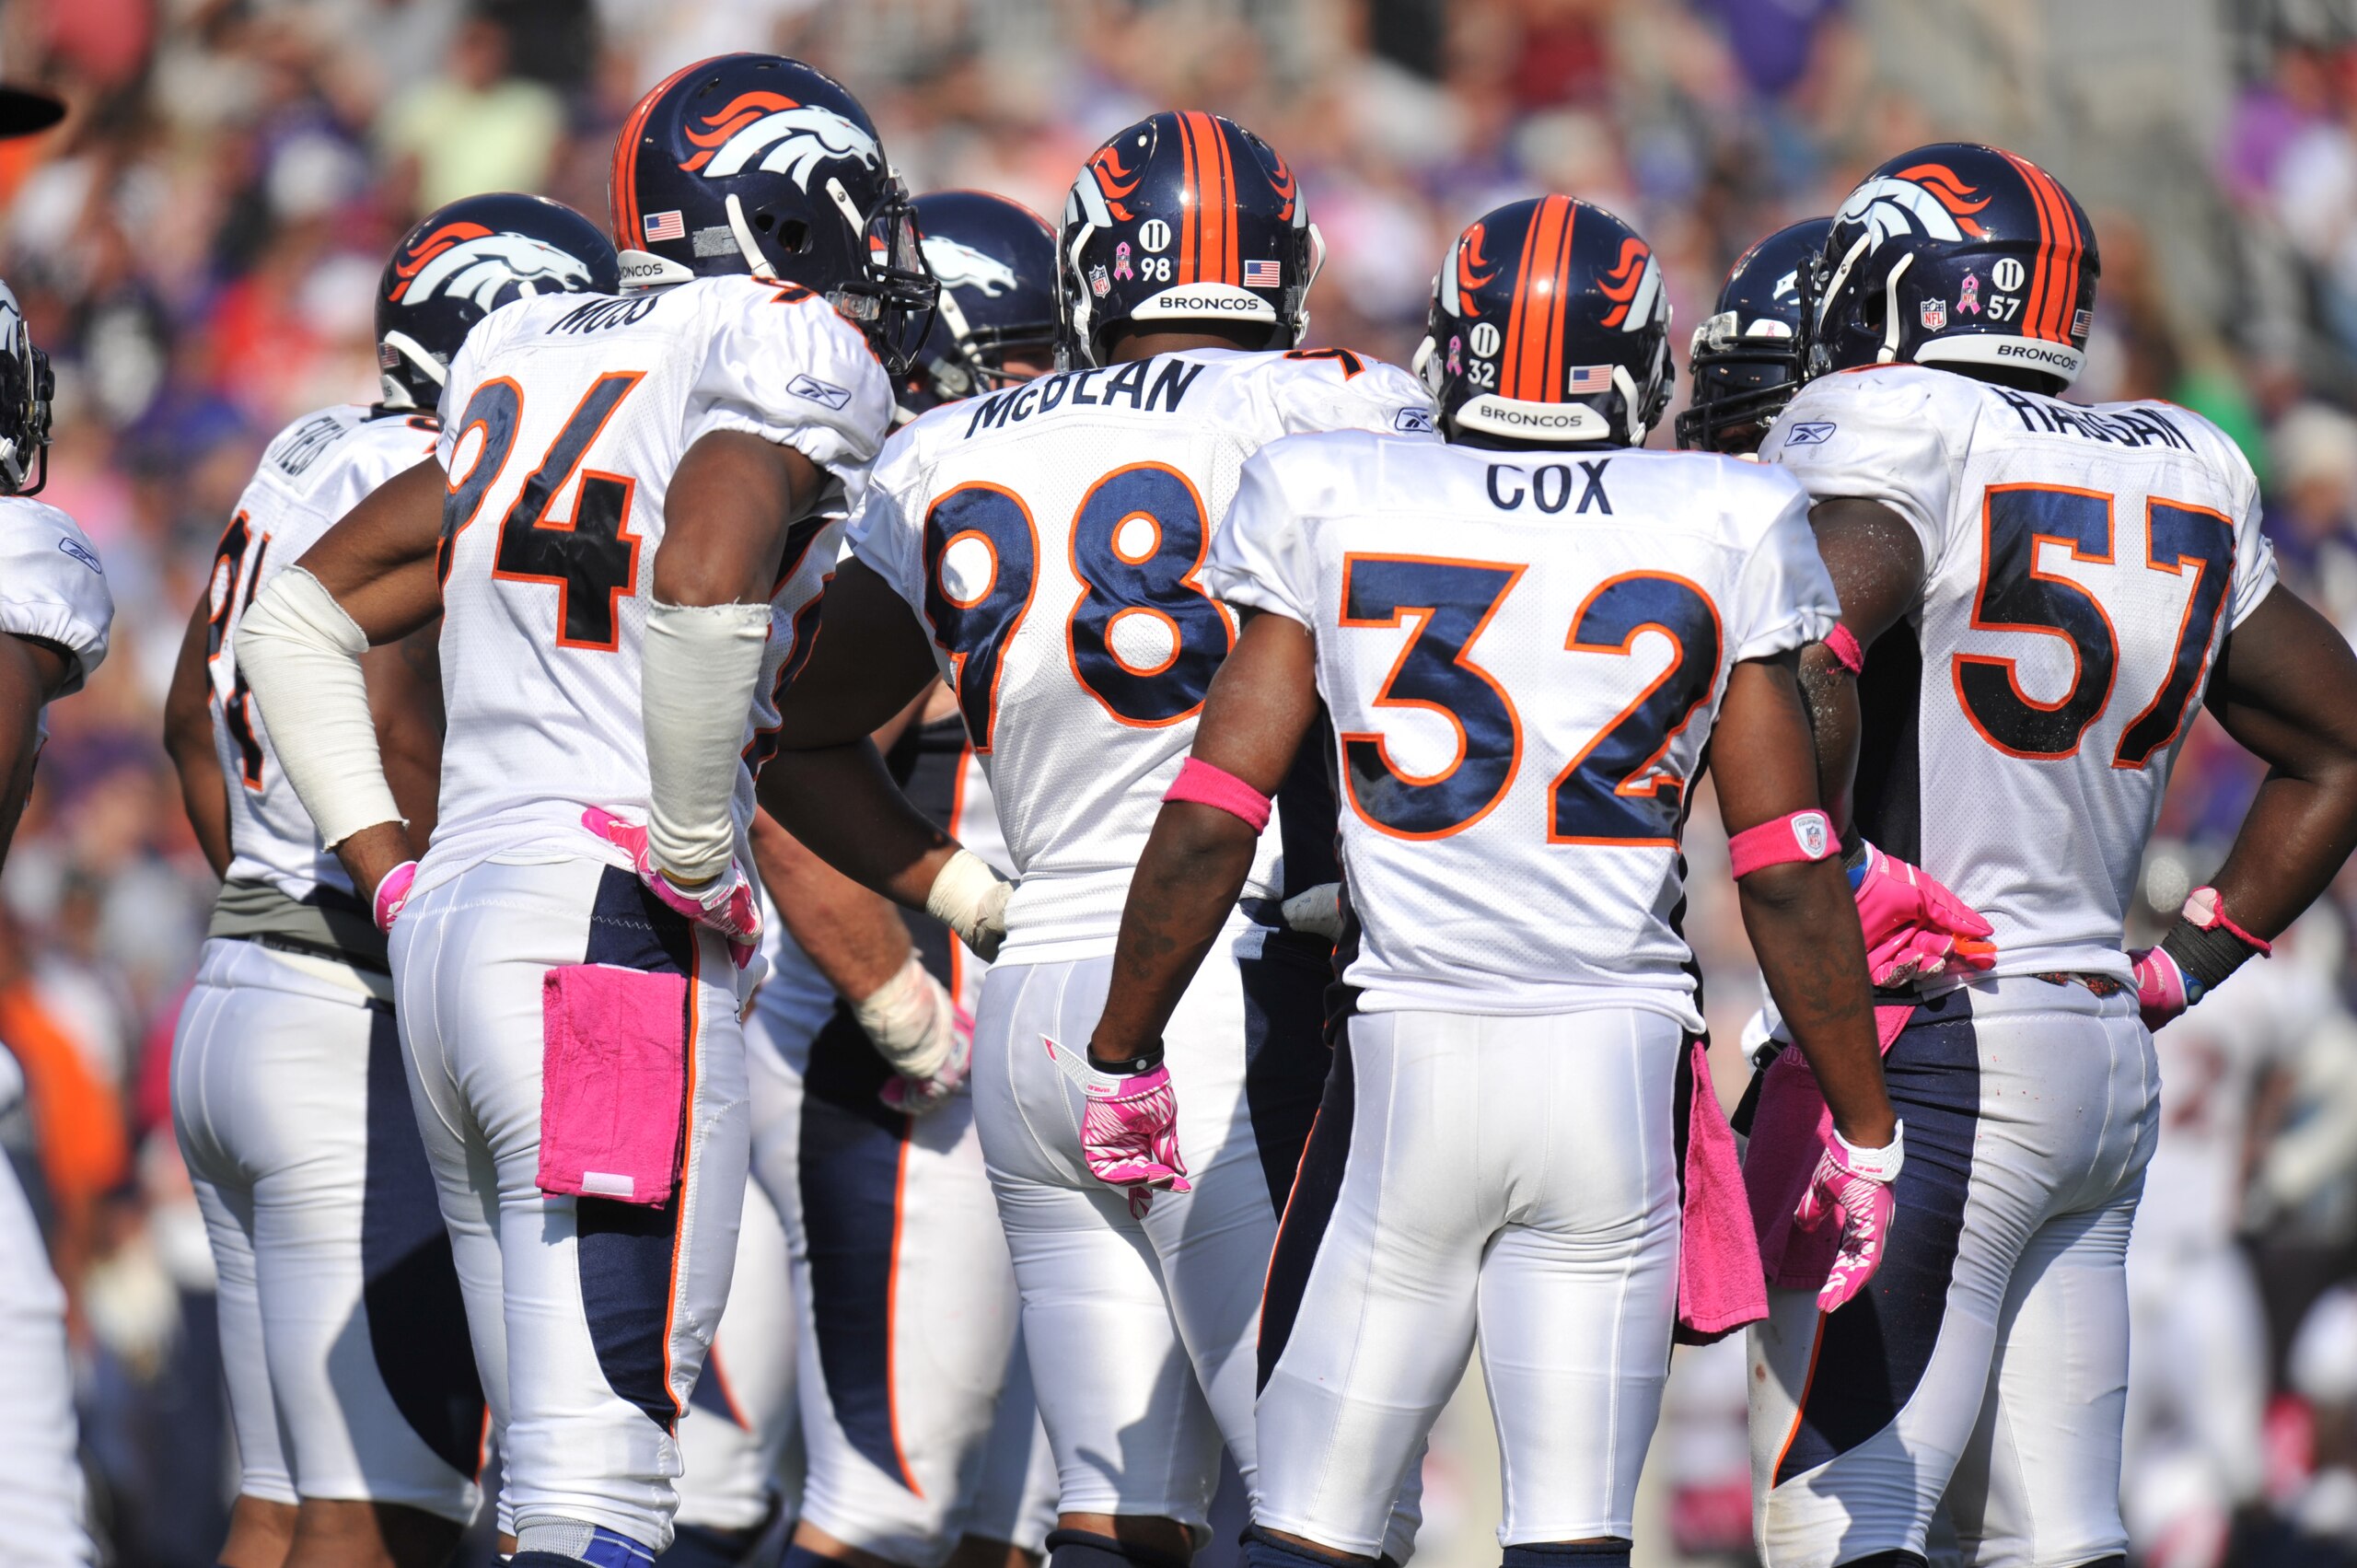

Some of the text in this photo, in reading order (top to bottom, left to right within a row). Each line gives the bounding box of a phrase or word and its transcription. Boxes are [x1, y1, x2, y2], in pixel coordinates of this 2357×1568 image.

[1147, 223, 1163, 249] 11
[1140, 257, 1171, 282] 98
[2002, 261, 2017, 288] 11
[1159, 296, 1259, 311] BRONCOS
[1987, 295, 2021, 321] 57
[1925, 311, 1944, 325] NFL
[1478, 327, 1493, 354] 11
[1997, 344, 2078, 371] BRONCOS
[1467, 358, 1495, 389] 32
[1480, 404, 1583, 427] BRONCOS
[1486, 458, 1613, 516] COX
[923, 460, 1235, 753] 98
[1951, 482, 2237, 769] 57
[1339, 552, 1724, 854] 32
